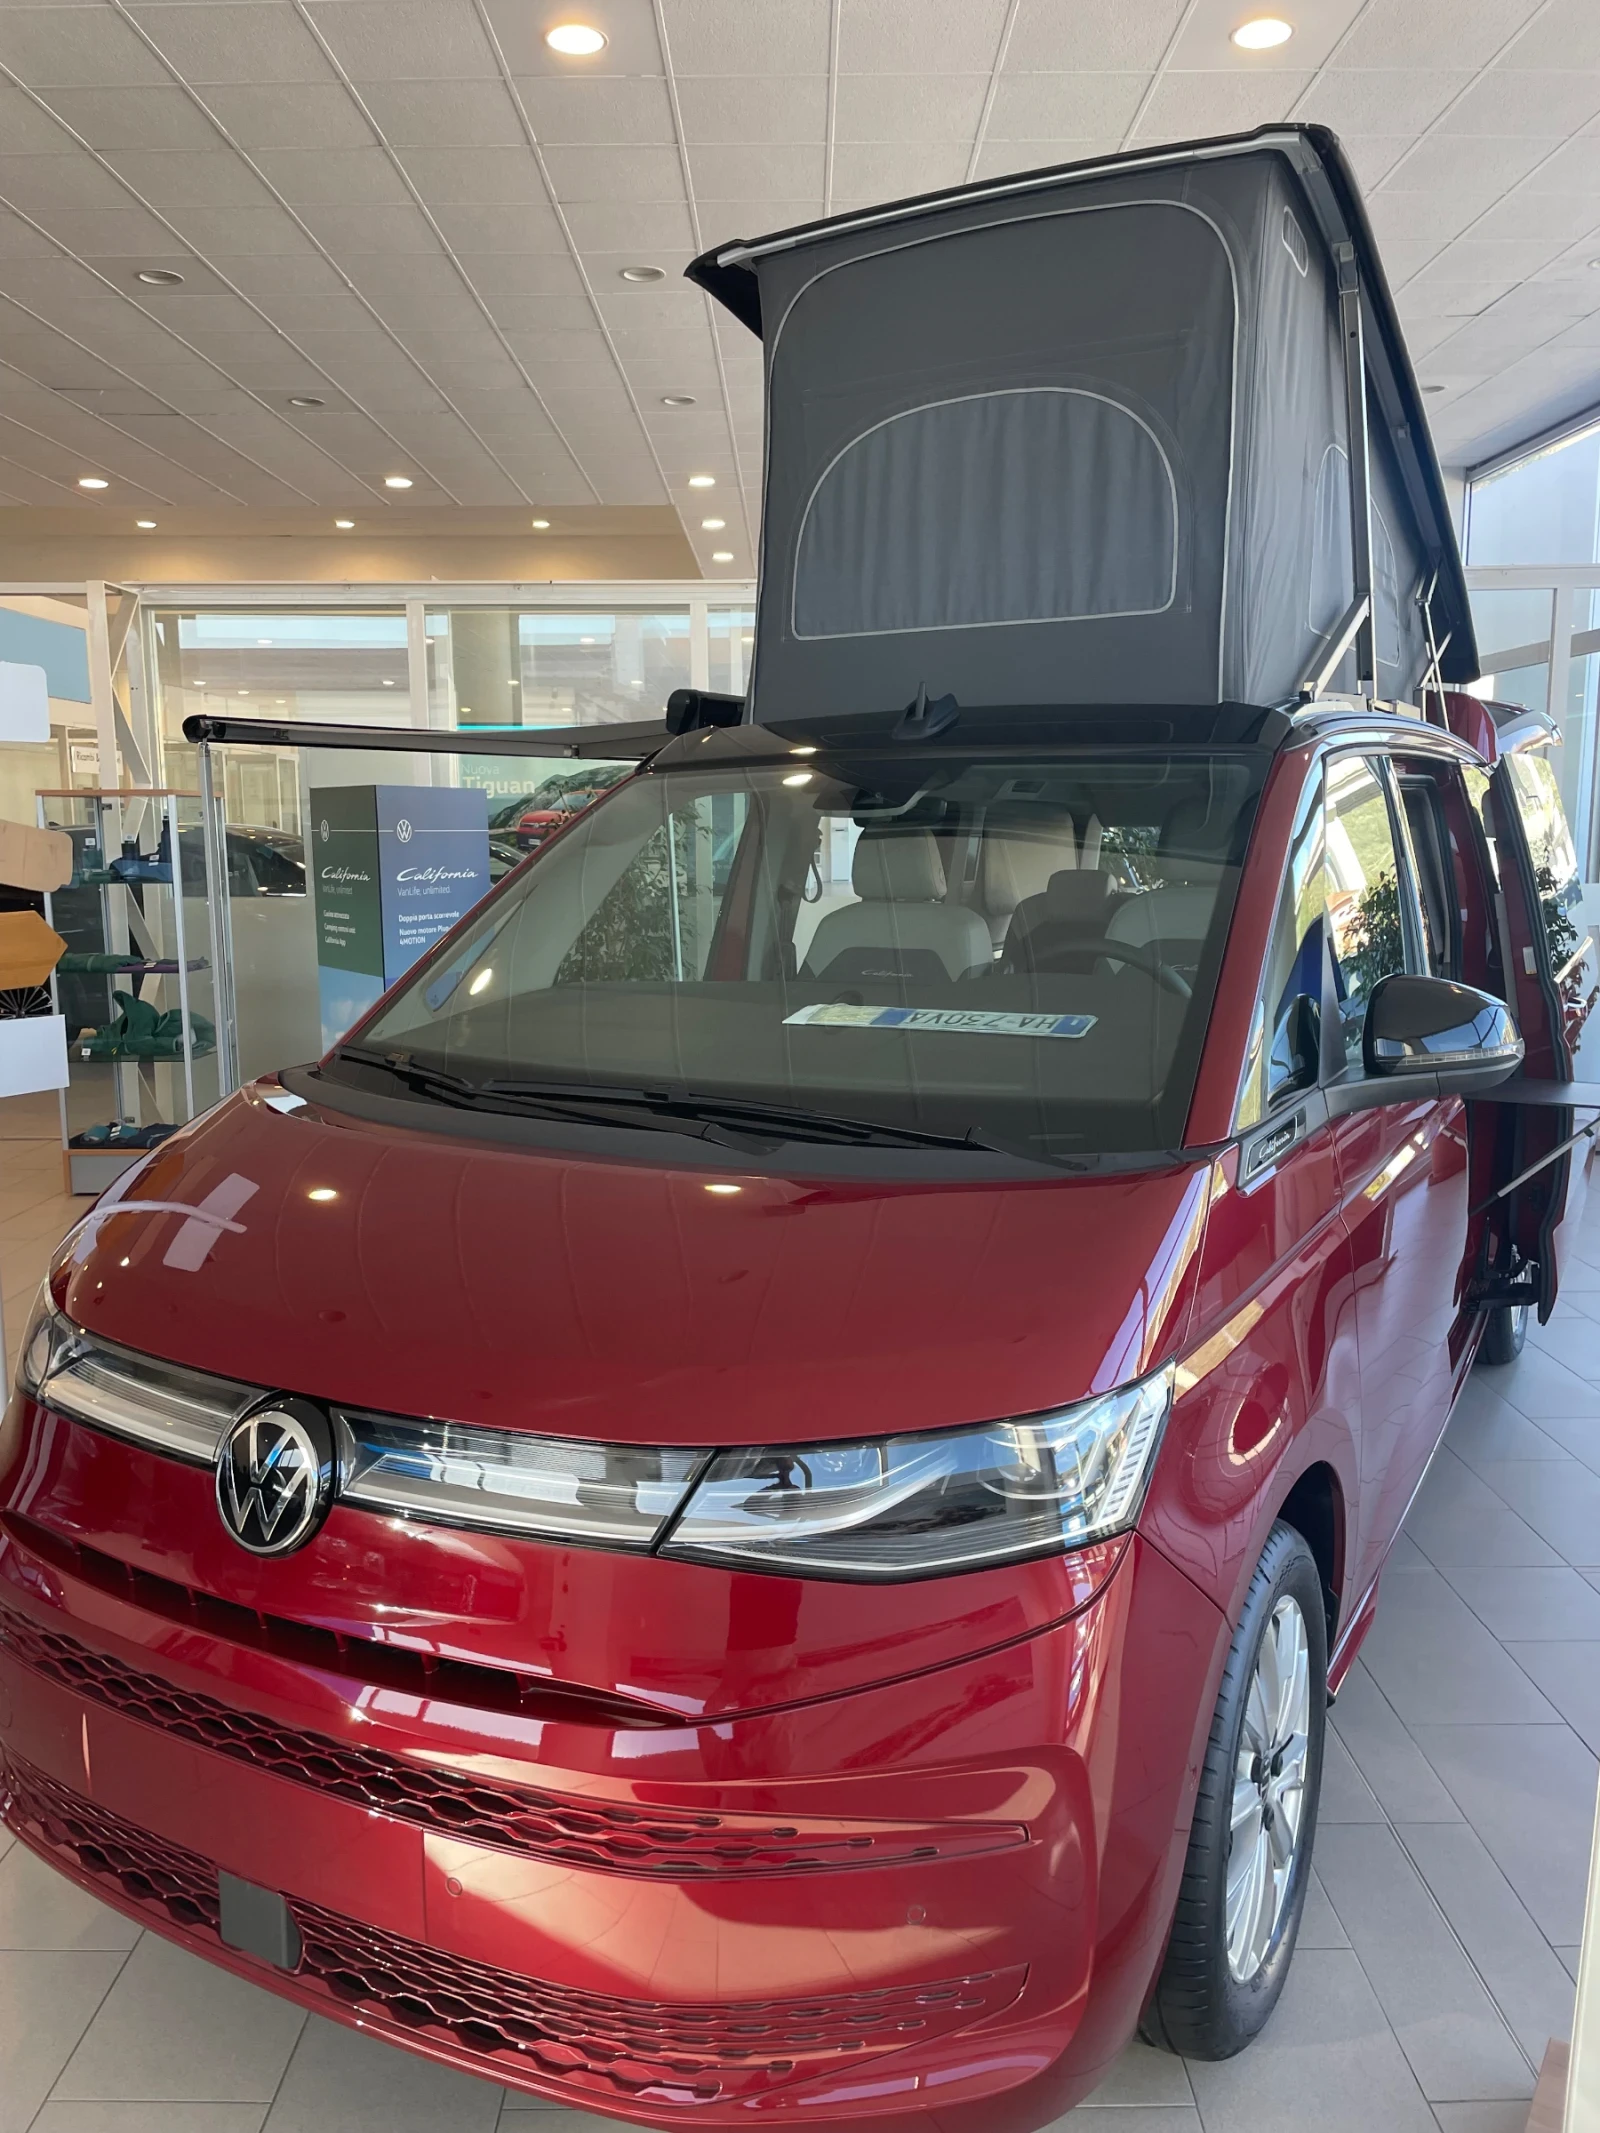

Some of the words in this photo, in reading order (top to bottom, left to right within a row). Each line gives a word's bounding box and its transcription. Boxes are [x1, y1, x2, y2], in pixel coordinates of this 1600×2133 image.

[462, 763, 500, 775] Nuova
[462, 776, 535, 798] Tiguan
[321, 865, 371, 883] California
[396, 866, 479, 883] California
[398, 914, 418, 923] Doppia
[418, 913, 433, 922] porta
[434, 911, 460, 919] scorrevole
[399, 928, 417, 936] Nuovo
[399, 936, 426, 945] 4MOTION
[1258, 1131, 1292, 1159] California
